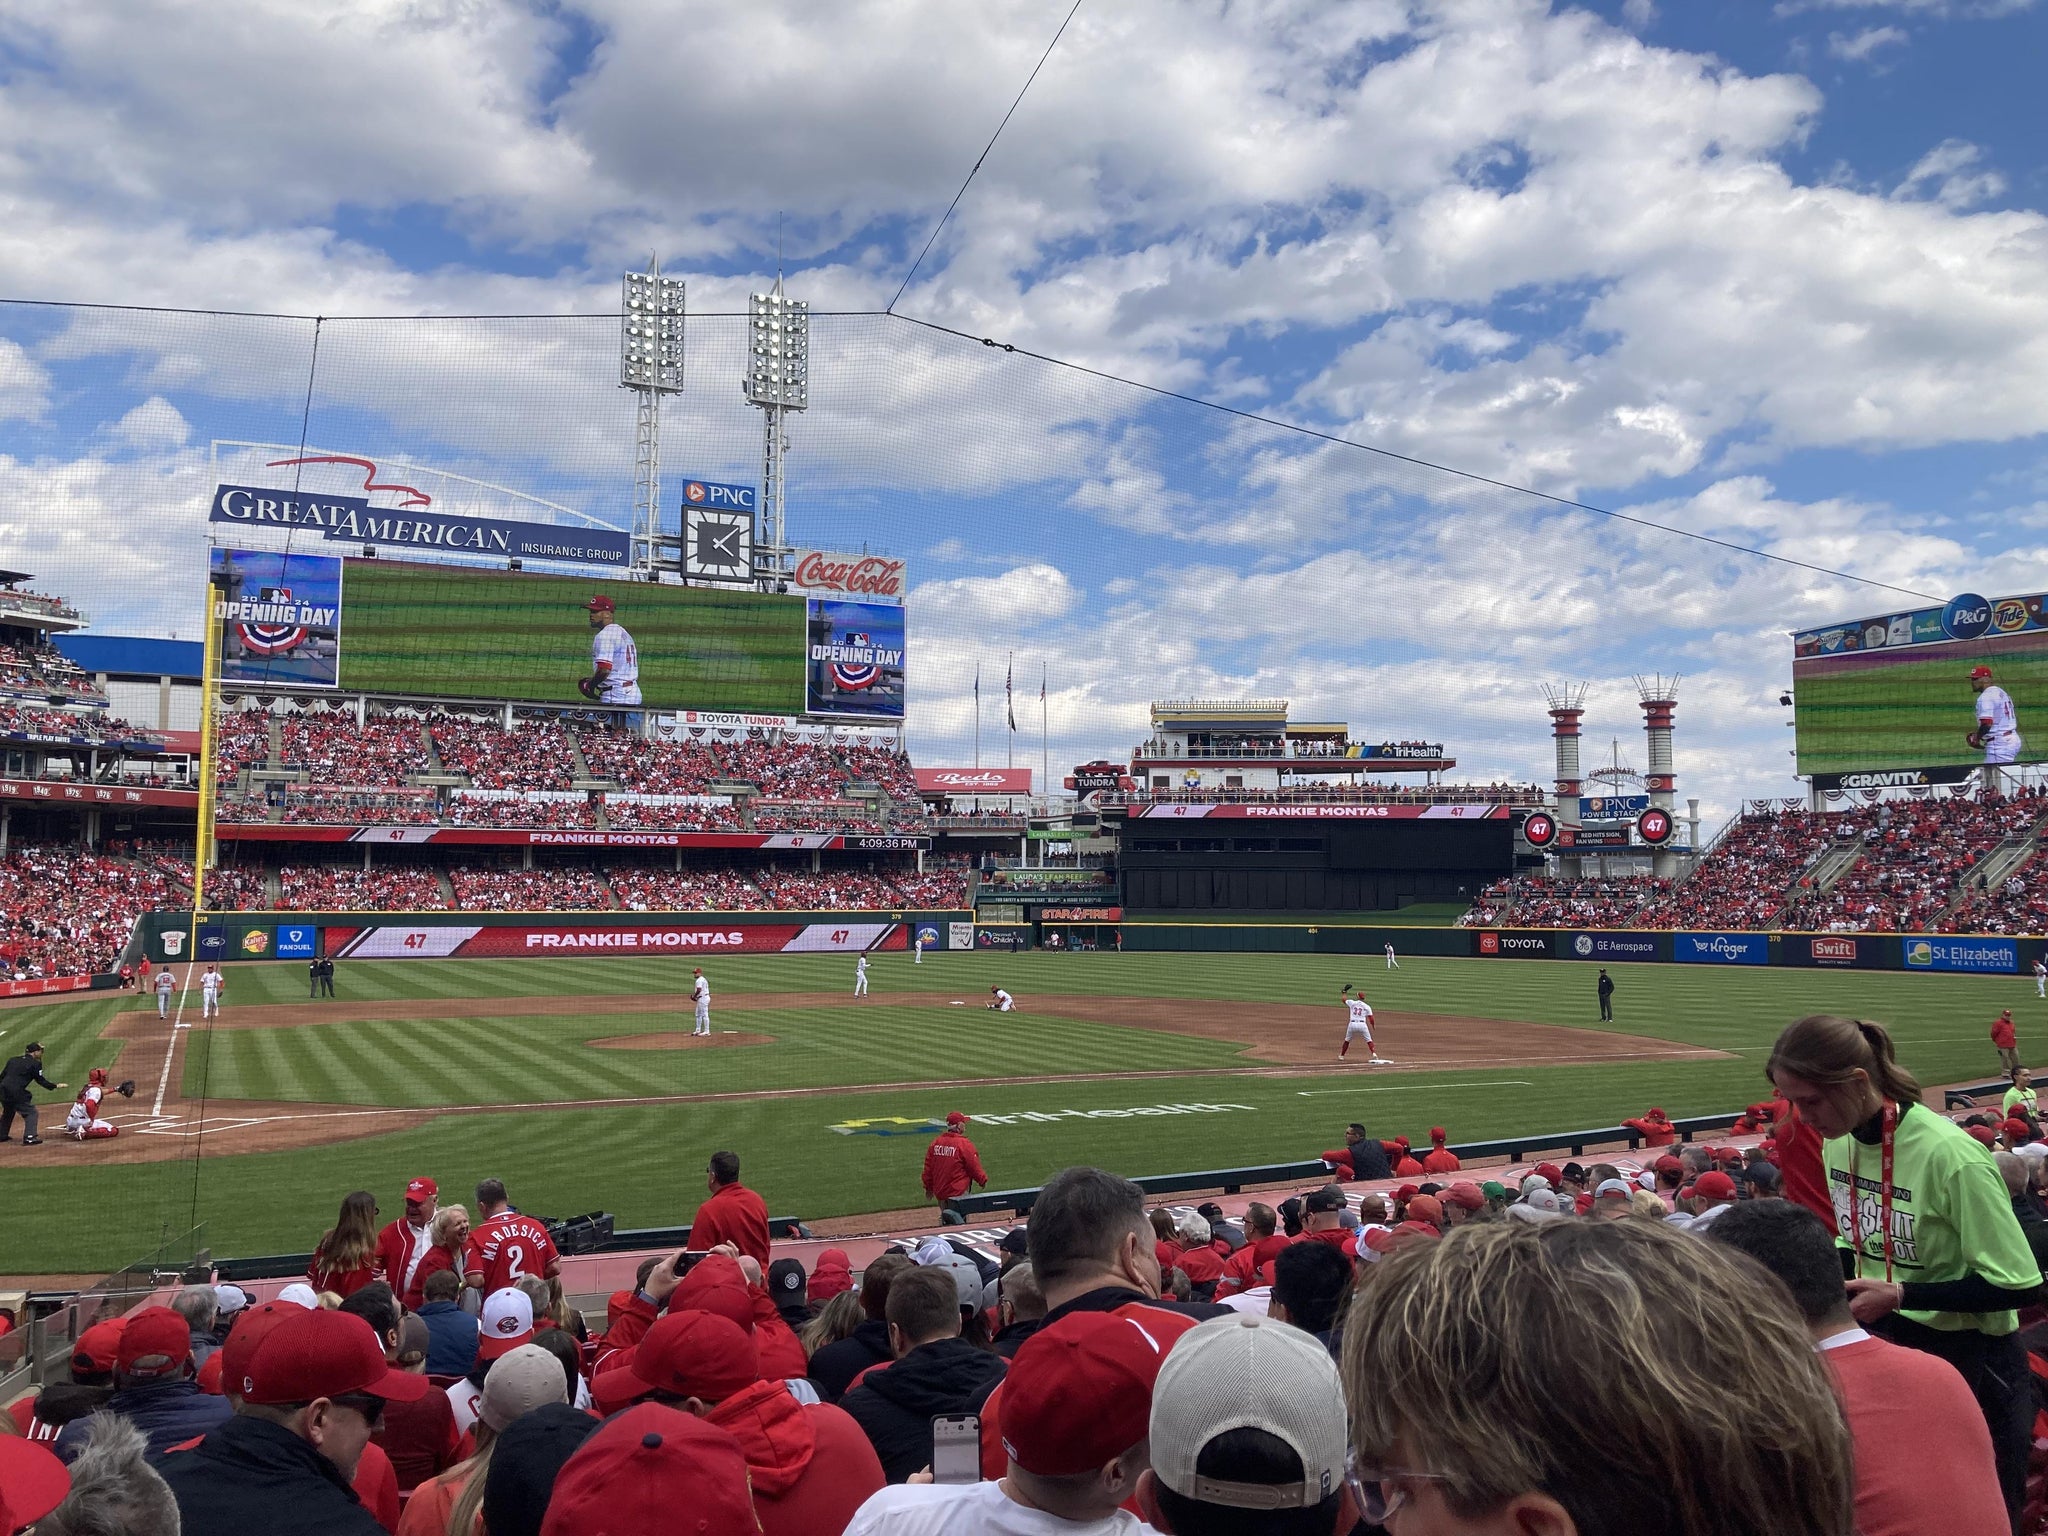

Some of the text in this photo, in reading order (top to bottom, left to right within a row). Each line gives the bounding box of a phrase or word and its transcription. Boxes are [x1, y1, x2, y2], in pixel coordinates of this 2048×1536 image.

[709, 486, 753, 506] PNC
[220, 490, 513, 551] GREAT AMERICAN
[520, 542, 623, 562] INSURANCE GROUP
[796, 551, 905, 595] Coca-Cola
[213, 601, 336, 626] OPENING DAY
[1952, 606, 1987, 626] P&G
[1996, 605, 2026, 629] Tide
[811, 644, 902, 667] OPENING DAY
[700, 713, 787, 726] TOYOTA TUNDRA
[27, 733, 44, 742] TRIPLE
[1393, 746, 1442, 758] TriHealth
[934, 772, 1007, 785] Reds
[1077, 778, 1115, 787] TUNDRA
[1849, 772, 1921, 788] GRAVITY
[33, 785, 48, 796] 1940
[65, 787, 80, 798] 1975
[1605, 797, 1637, 811] PNC
[1173, 806, 1187, 816] 47
[1246, 807, 1389, 817] FRANKIE MONTAS
[1450, 806, 1465, 817] 47
[1581, 811, 1611, 819] POWER
[1531, 823, 1547, 836] 47
[1646, 819, 1663, 832] 47
[389, 830, 405, 841] 47
[529, 833, 679, 845] FRANKIE MONTAS
[791, 837, 804, 848] 47
[858, 837, 917, 849] 4:09:36 PM
[1041, 908, 1109, 920] STAR FIRE
[168, 939, 178, 948] 35
[243, 932, 269, 949] Kahn's
[404, 933, 427, 949] 47
[526, 932, 744, 948] FRANKIE MONTAS
[830, 930, 850, 944] 47
[1501, 938, 1545, 949] TOYOTA
[1768, 935, 1781, 943] 370
[1597, 941, 1654, 953] GE Aerospace
[1710, 937, 1748, 960] Kroger
[1815, 941, 1851, 956] Swift
[1932, 946, 2013, 962] St. Elizabeth
[1951, 960, 2014, 968] HEALTHCARE
[967, 1101, 1259, 1126] TriHealth
[933, 1144, 957, 1158] SECURITY
[480, 1223, 548, 1262] MARDESICH
[507, 1245, 526, 1280] 2
